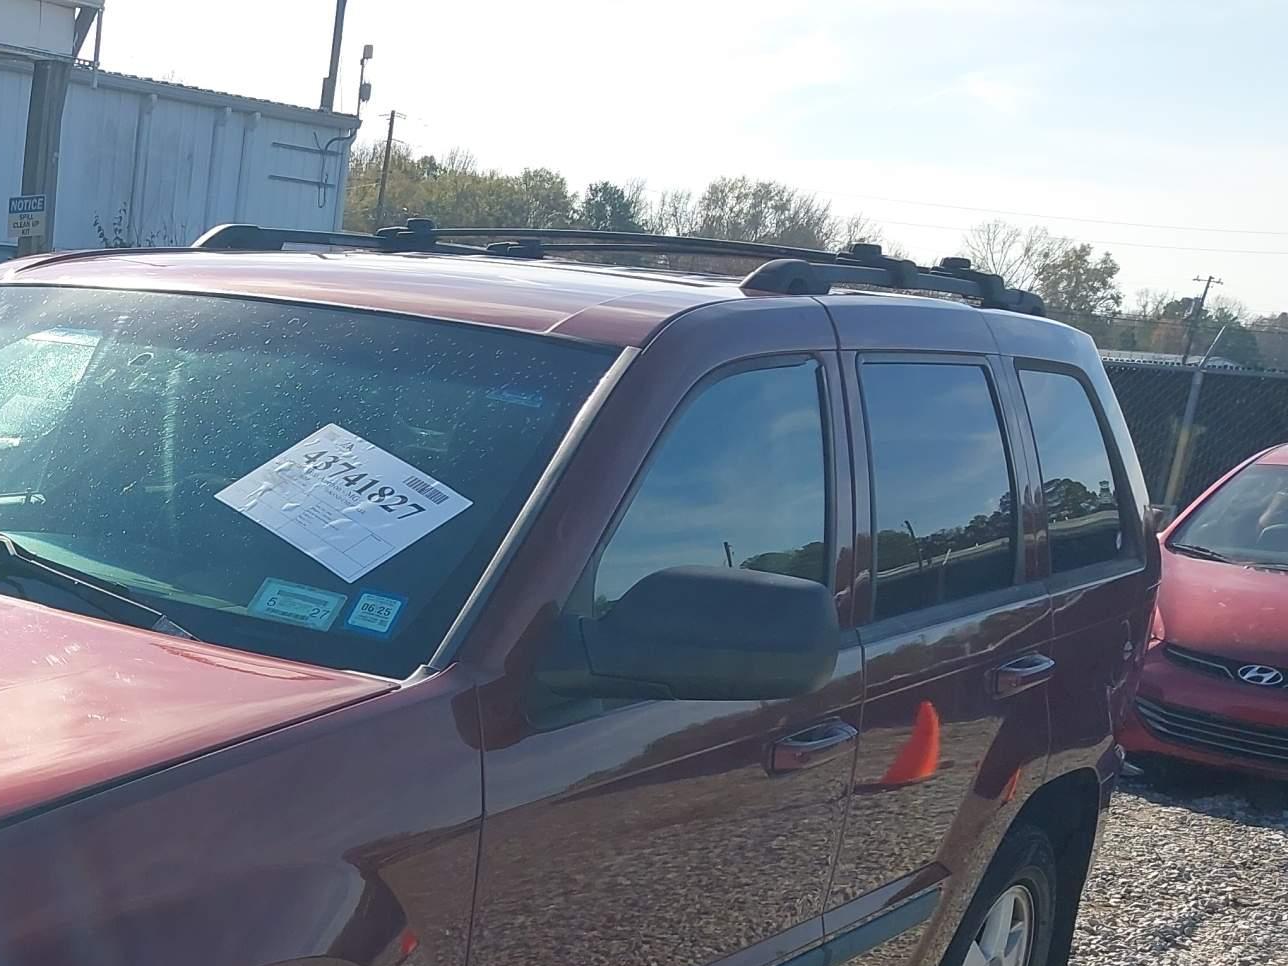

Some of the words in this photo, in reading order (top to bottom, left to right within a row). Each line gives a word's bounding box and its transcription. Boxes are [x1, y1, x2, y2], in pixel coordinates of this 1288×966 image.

[10, 198, 44, 211] NOTICE
[304, 450, 426, 520] 43741827
[309, 606, 331, 620] 27
